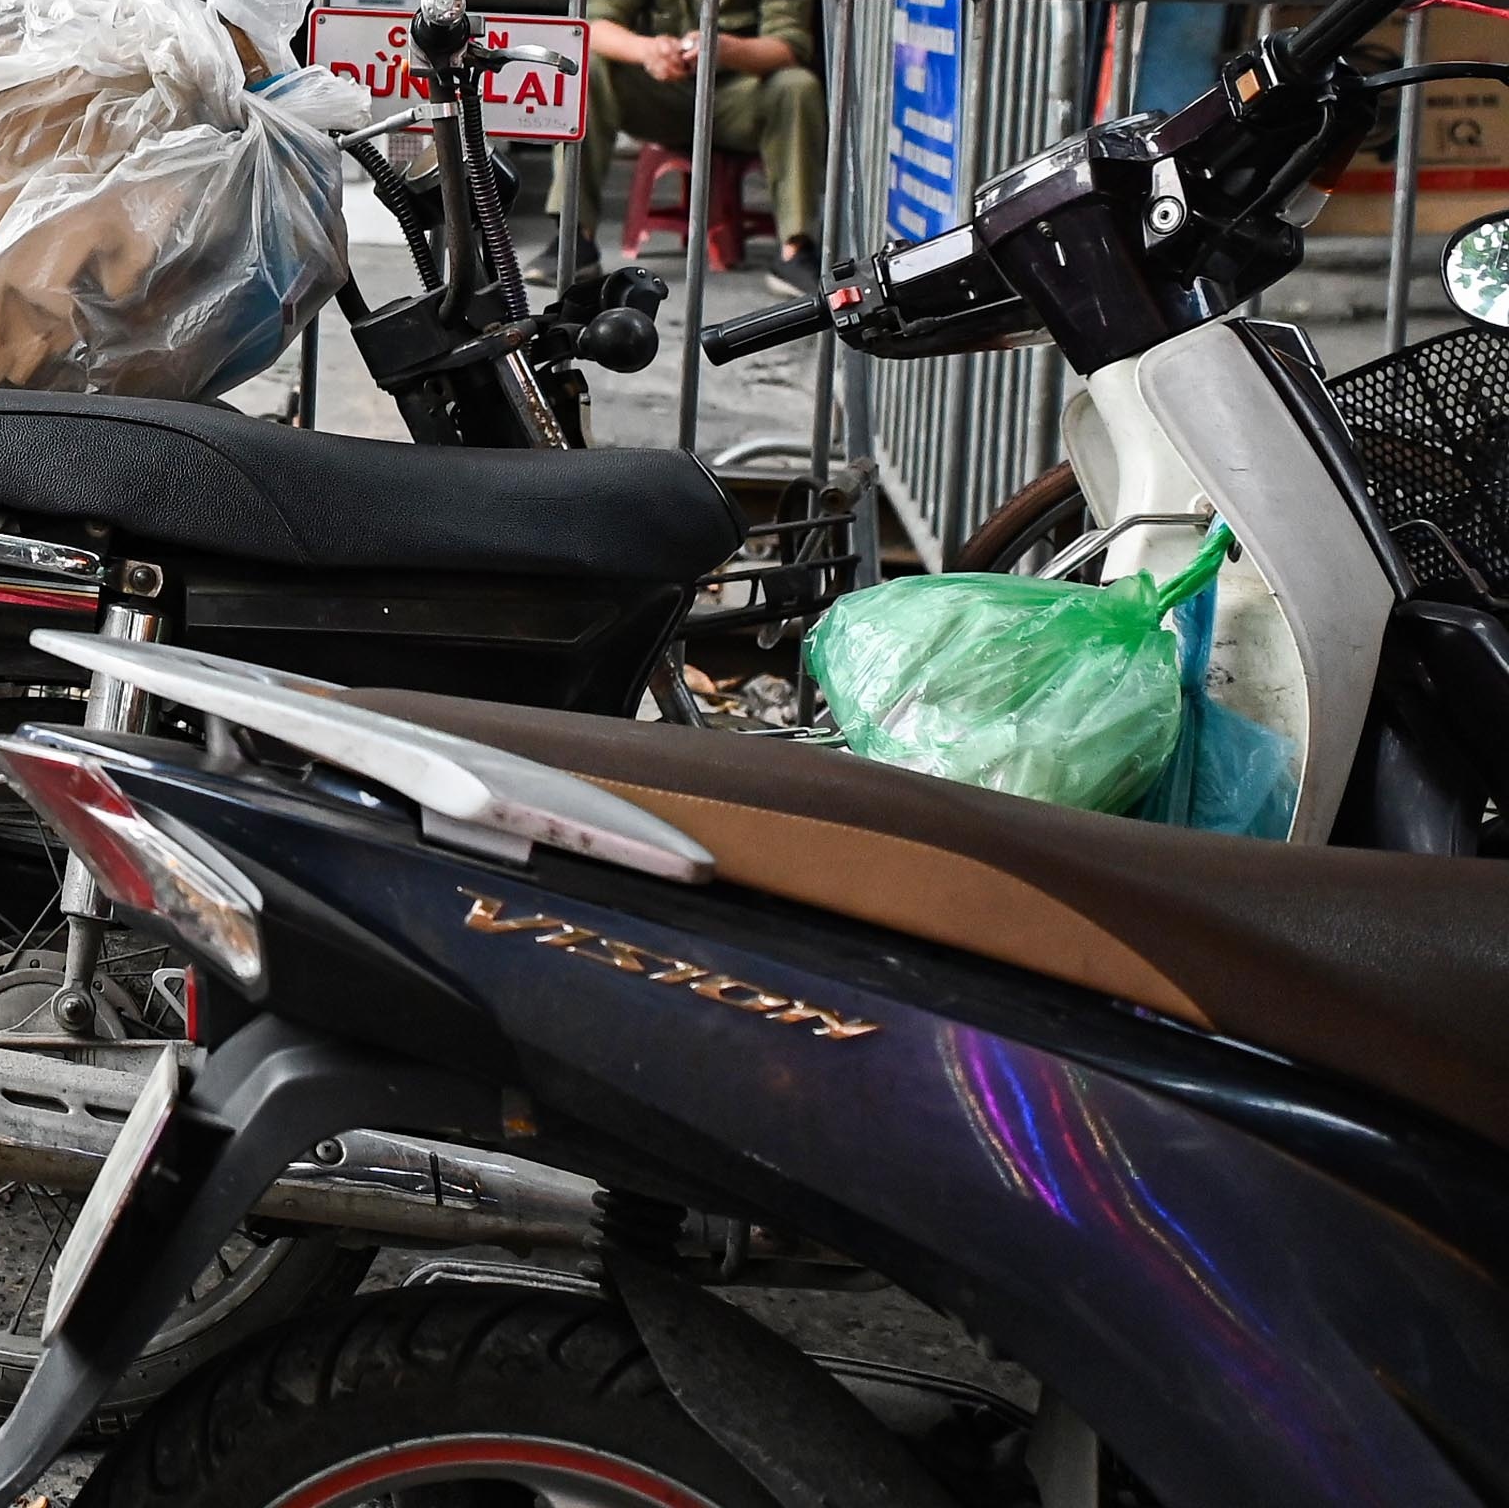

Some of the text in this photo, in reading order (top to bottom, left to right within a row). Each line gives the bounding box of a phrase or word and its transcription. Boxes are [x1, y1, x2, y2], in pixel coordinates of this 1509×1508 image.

[387, 26, 509, 50] CN
[483, 70, 564, 114] LẠI
[456, 885, 880, 1040] VISION
